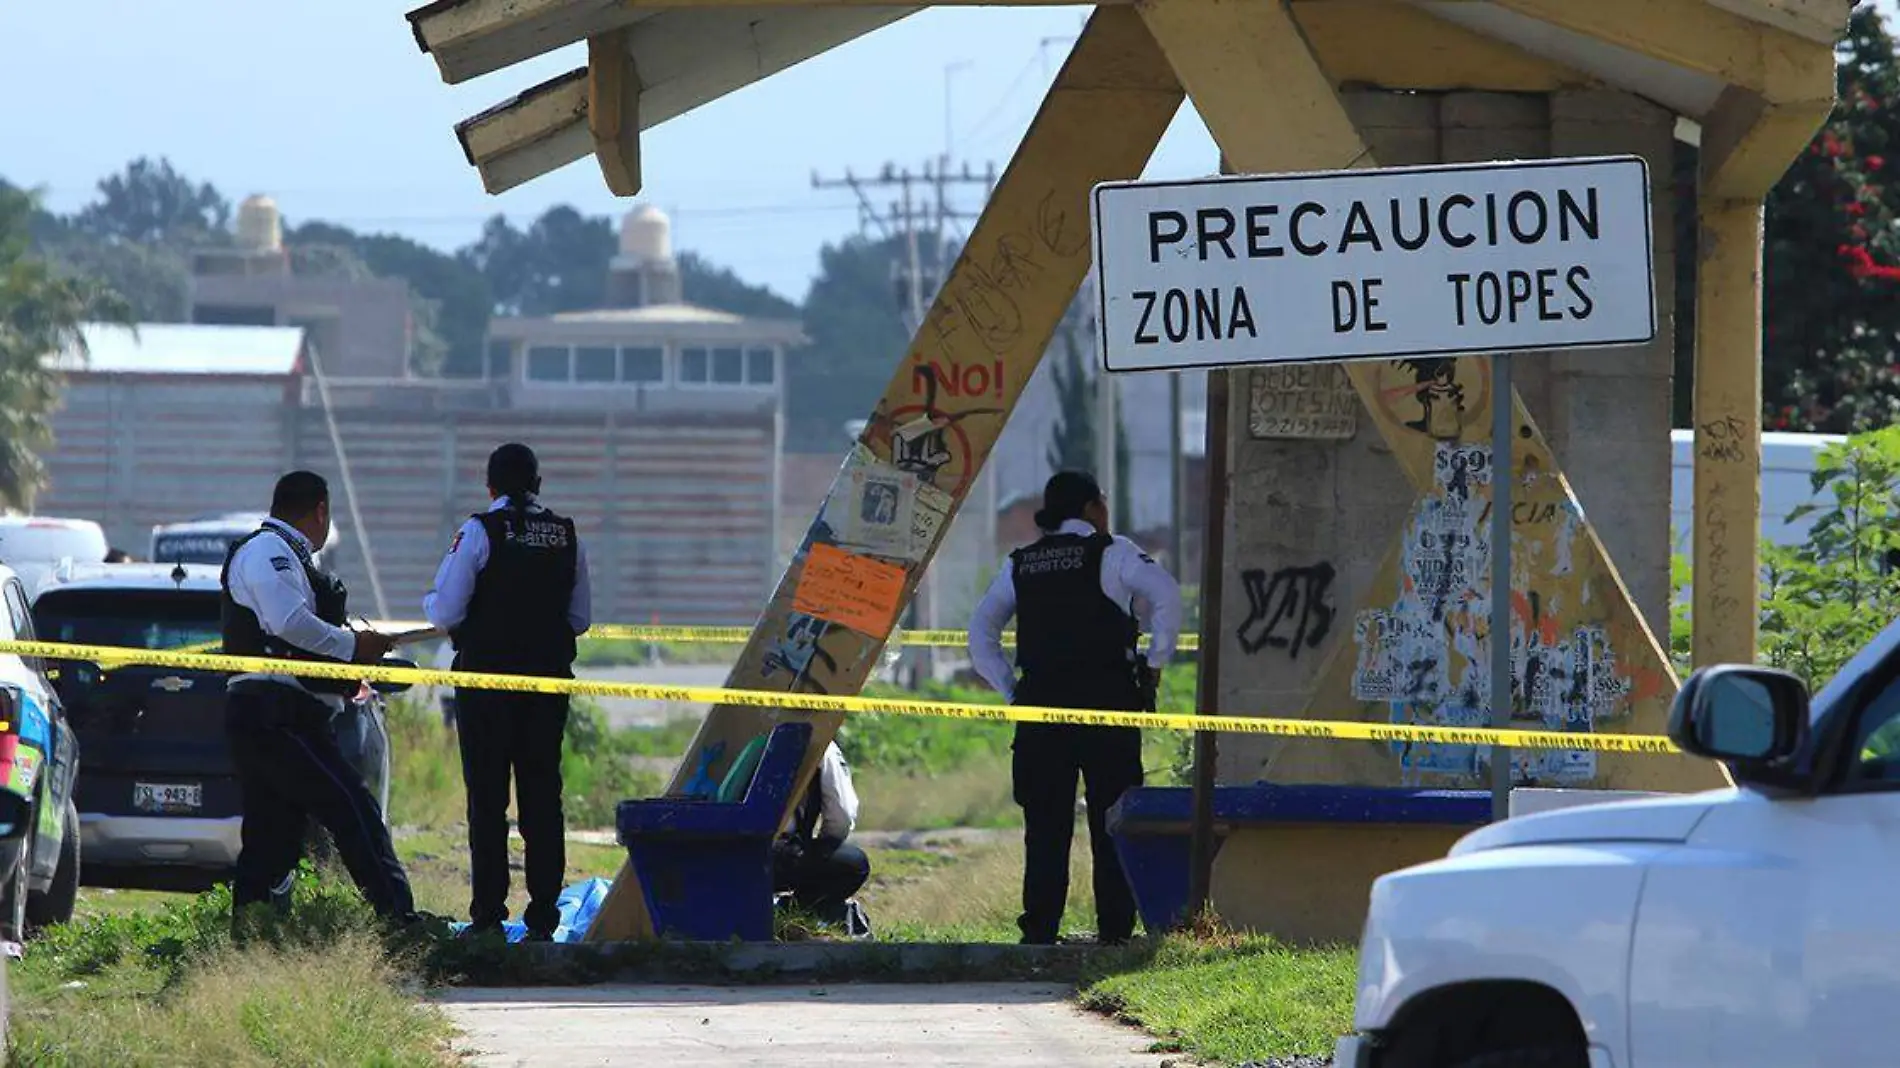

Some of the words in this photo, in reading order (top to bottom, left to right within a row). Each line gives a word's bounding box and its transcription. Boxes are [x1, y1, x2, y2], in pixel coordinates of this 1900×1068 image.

[1149, 187, 1600, 262] PRECAUCION
[1132, 287, 1258, 345] ZONA
[1331, 278, 1388, 333] DE
[1446, 266, 1594, 327] TOPES
[1436, 449, 1493, 472] $69
[1019, 557, 1084, 575] PERITOS
